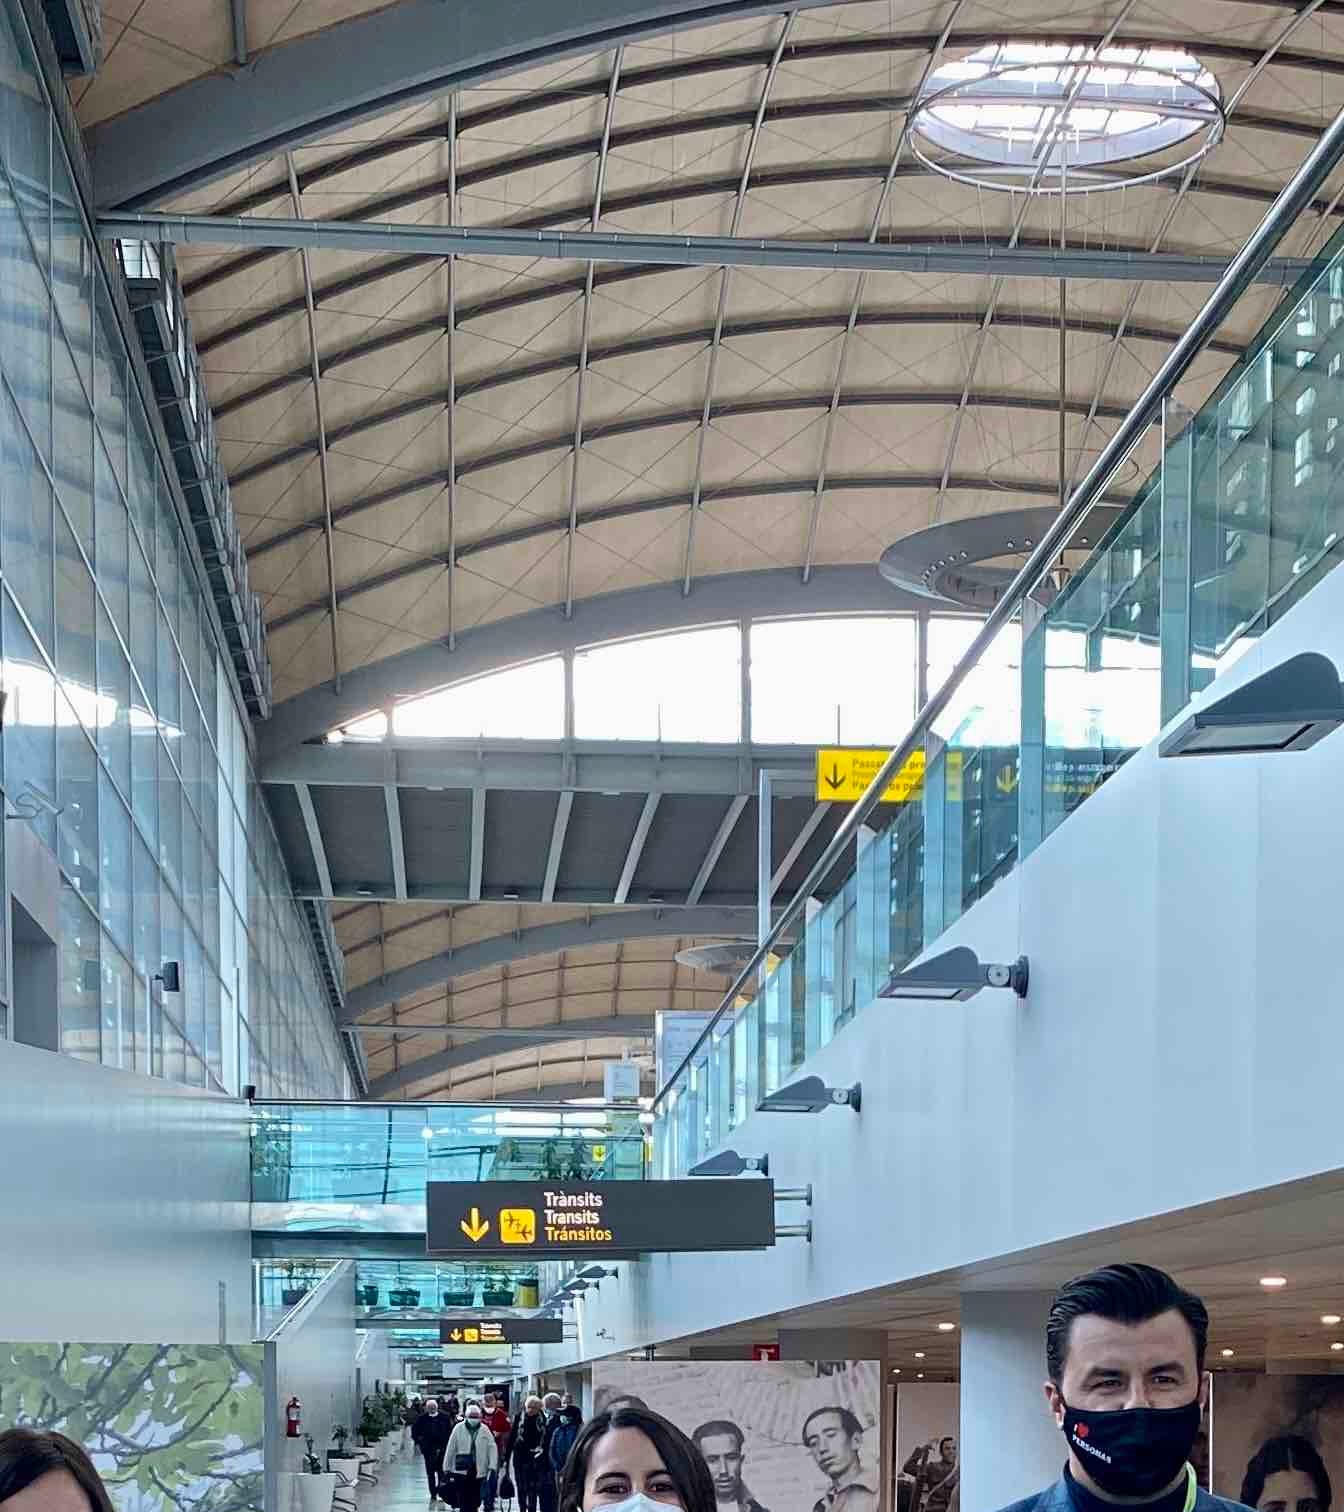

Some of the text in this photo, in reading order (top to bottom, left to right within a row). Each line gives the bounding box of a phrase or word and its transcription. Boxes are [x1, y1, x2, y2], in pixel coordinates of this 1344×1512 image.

[544, 1191, 603, 1207] Trànsits
[544, 1209, 600, 1225] Transits
[544, 1226, 613, 1242] Tránsitos
[1072, 1434, 1112, 1464] PERSONAS
